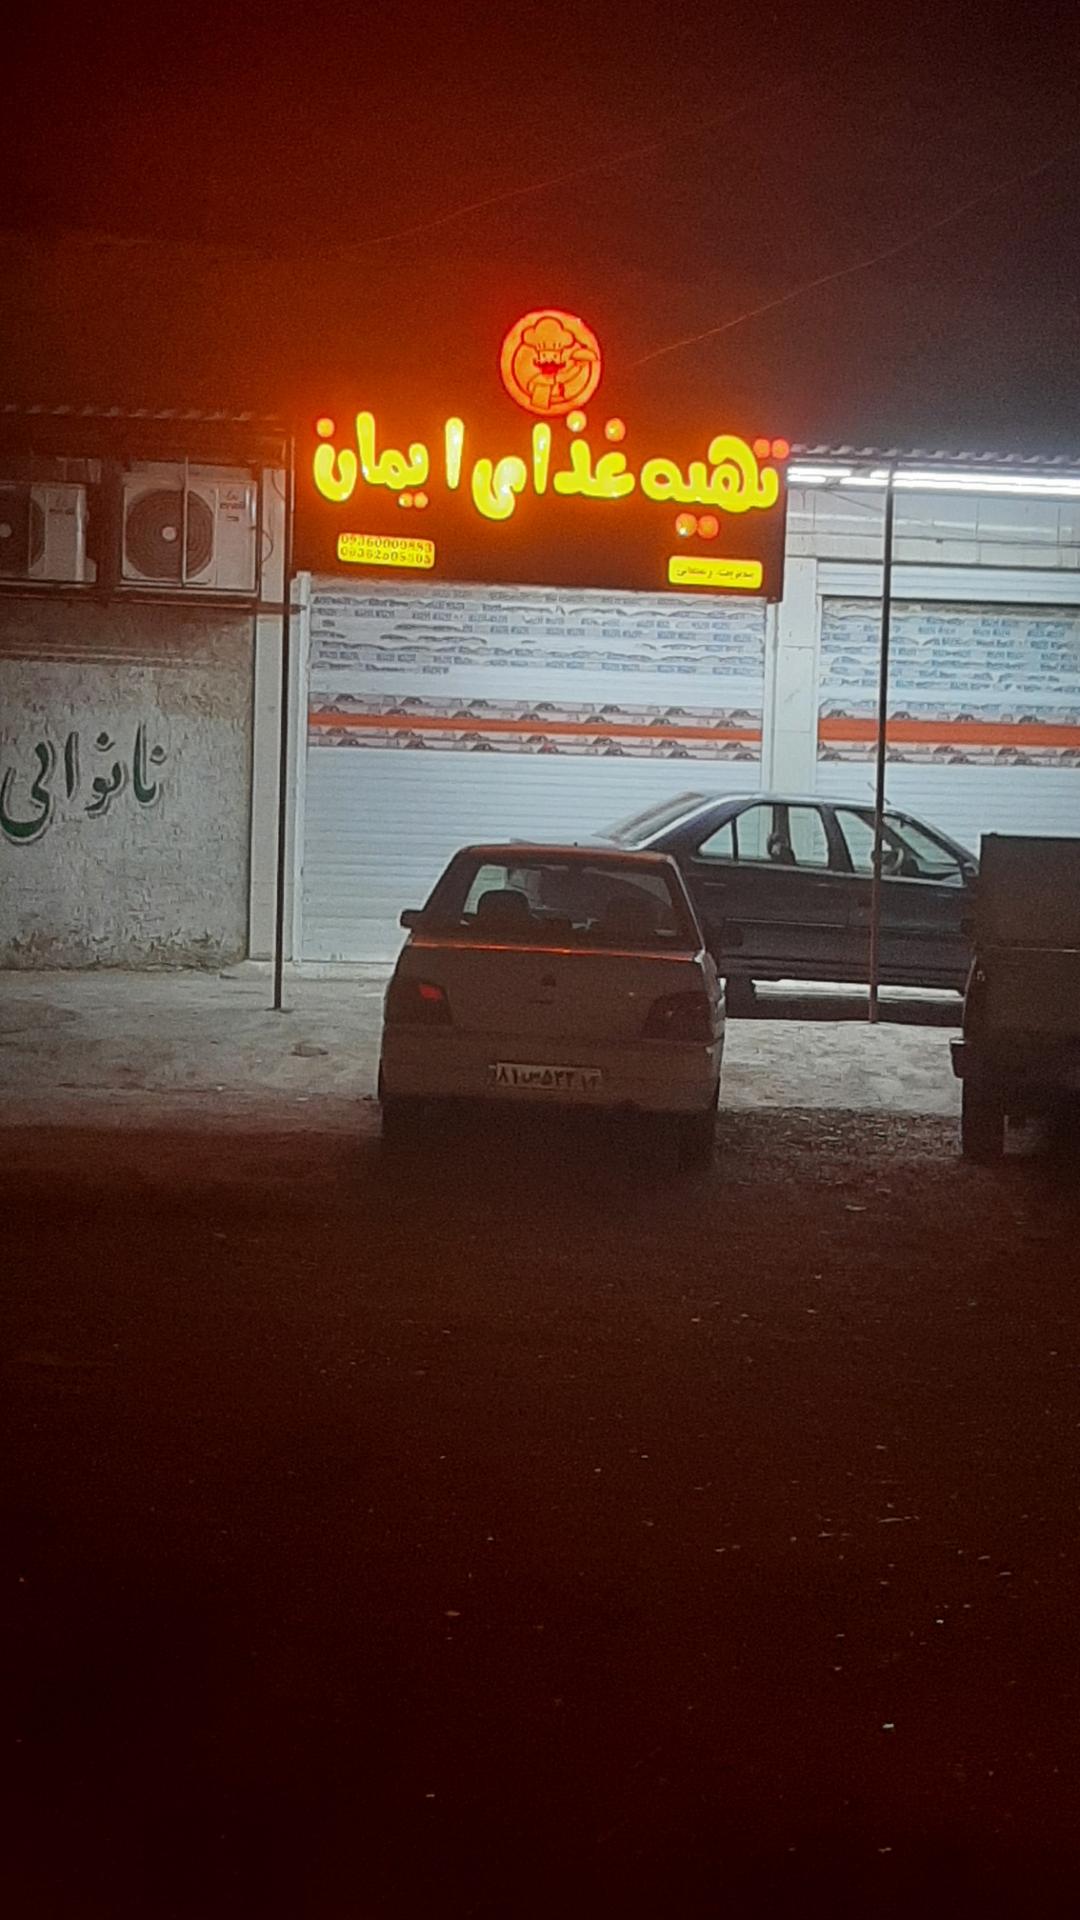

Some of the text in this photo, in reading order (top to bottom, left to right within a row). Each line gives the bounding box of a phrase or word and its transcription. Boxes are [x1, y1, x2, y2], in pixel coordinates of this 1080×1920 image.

[313, 410, 789, 540] تهیه غذای ایمان
